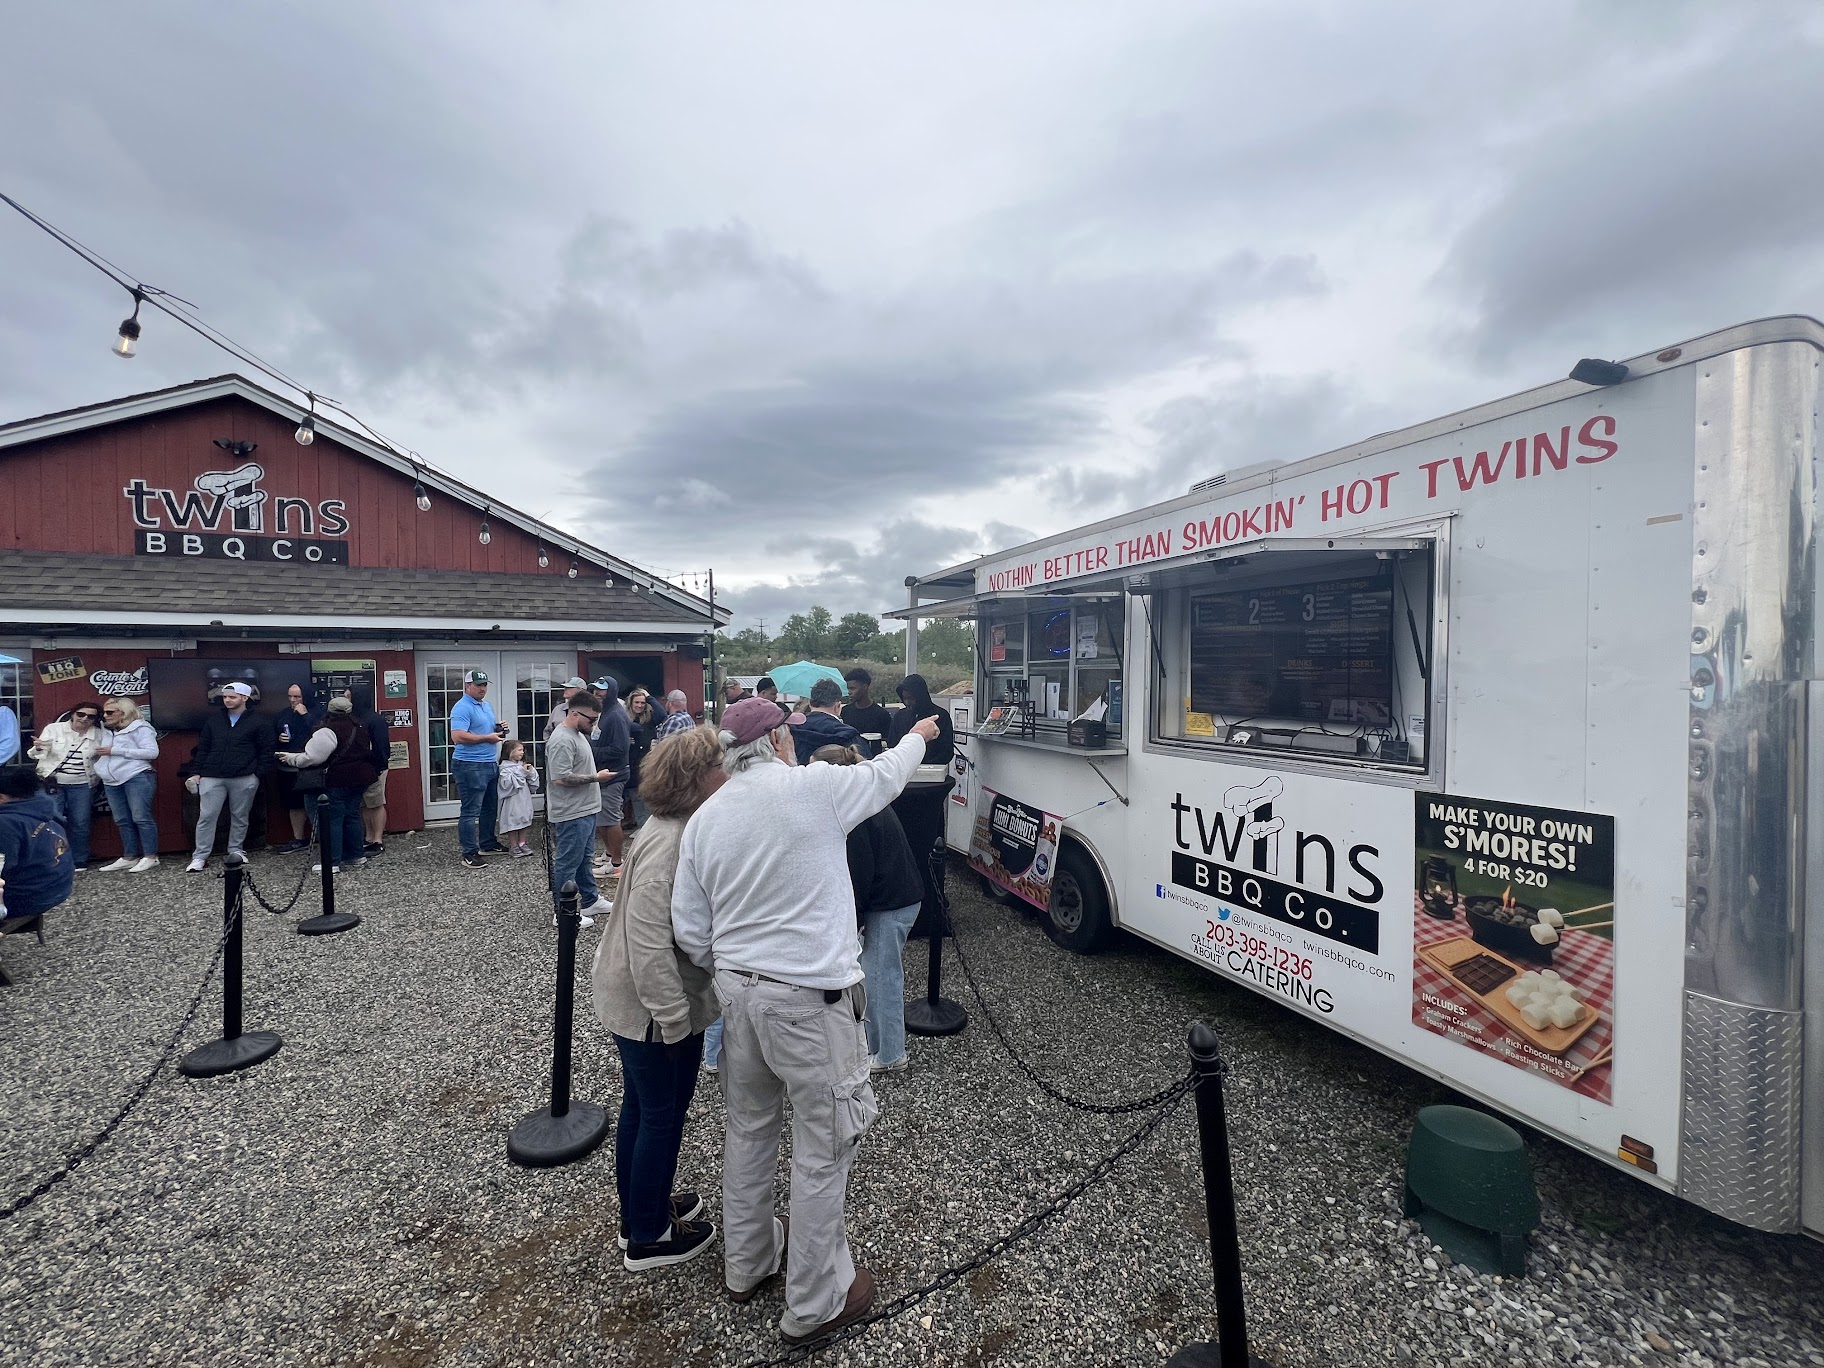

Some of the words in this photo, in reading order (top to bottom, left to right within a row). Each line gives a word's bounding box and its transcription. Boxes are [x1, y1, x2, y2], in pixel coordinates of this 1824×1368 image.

[123, 479, 350, 536] twins
[989, 562, 1038, 592] NOTHIN'
[1043, 546, 1108, 580] BETTER
[1115, 529, 1172, 565] THAN
[1182, 495, 1306, 551] SMOKIN'
[1321, 471, 1400, 521] HOT
[1419, 415, 1618, 499] TWINS
[146, 533, 245, 560] BBQ
[1248, 599, 1260, 625] 2
[1302, 593, 1315, 622] 3
[48, 662, 74, 672] BBQ
[48, 669, 80, 681] ZONE
[1287, 659, 1313, 667] DRINKS
[90, 670, 136, 688] Counter
[98, 680, 149, 696] Weight
[1008, 815, 1038, 842] DONUTS
[1429, 802, 1479, 827] MAKE
[1483, 810, 1536, 836] YOUR
[1540, 819, 1593, 845] OWN
[1171, 793, 1384, 904] twins
[1444, 824, 1577, 872] S'MORES!
[1464, 858, 1475, 873] 4
[1478, 860, 1511, 881] FOR
[1514, 866, 1548, 888] $20
[1167, 890, 1209, 912] twinsbbqco
[1195, 863, 1263, 908] BBQ
[1285, 892, 1348, 937] Co.
[1190, 933, 1212, 951] CALL
[1215, 943, 1226, 955] US
[1193, 945, 1222, 965] ABOUT
[1206, 920, 1313, 980] 203-395-1236
[1232, 913, 1293, 943] @twinsbbqco
[1303, 940, 1396, 982] twinsbbqco.com
[1227, 951, 1334, 1013] CATERING
[1422, 992, 1468, 1016] INCLUDES:
[1426, 1006, 1451, 1021] Graham
[1452, 1017, 1482, 1034] Crackers
[1426, 1017, 1447, 1032] Toasty
[1447, 1025, 1496, 1051] Marshmallows
[1505, 1037, 1522, 1050] Rich
[1523, 1044, 1563, 1066] Chocolate
[1565, 1060, 1585, 1075] Bars
[1505, 1048, 1539, 1070] Roasting
[1540, 1062, 1565, 1079] Sticks
